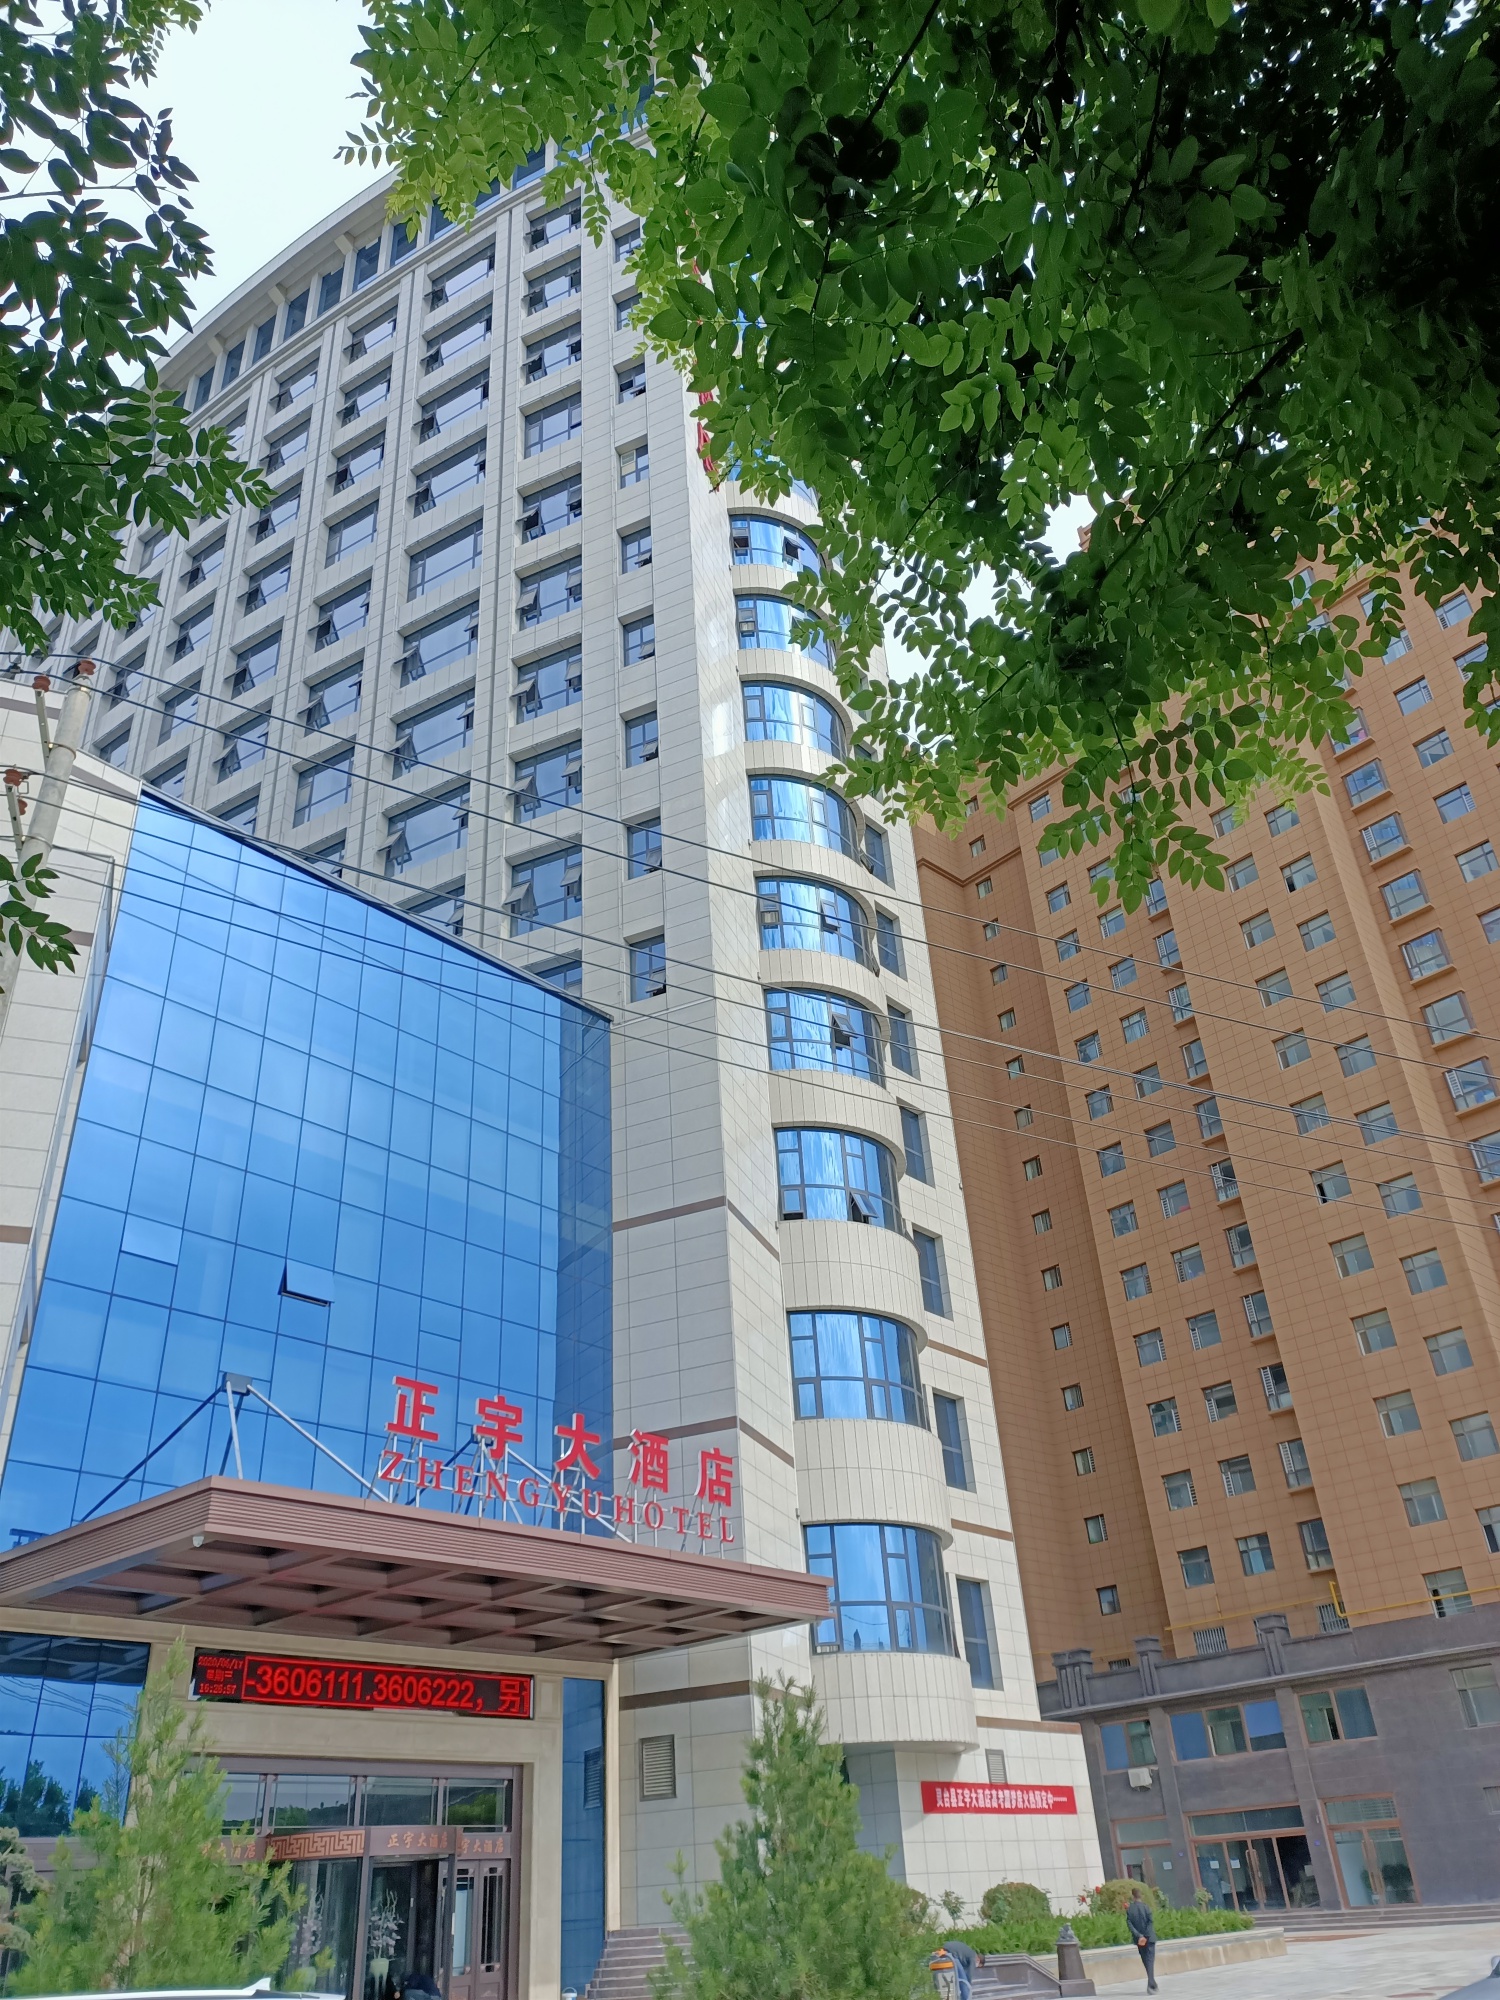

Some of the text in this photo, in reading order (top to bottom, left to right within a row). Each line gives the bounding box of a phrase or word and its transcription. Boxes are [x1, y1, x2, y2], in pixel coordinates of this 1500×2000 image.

[385, 1376, 734, 1507] 正宇大酒店
[387, 1831, 448, 1849] 正宇大酒店
